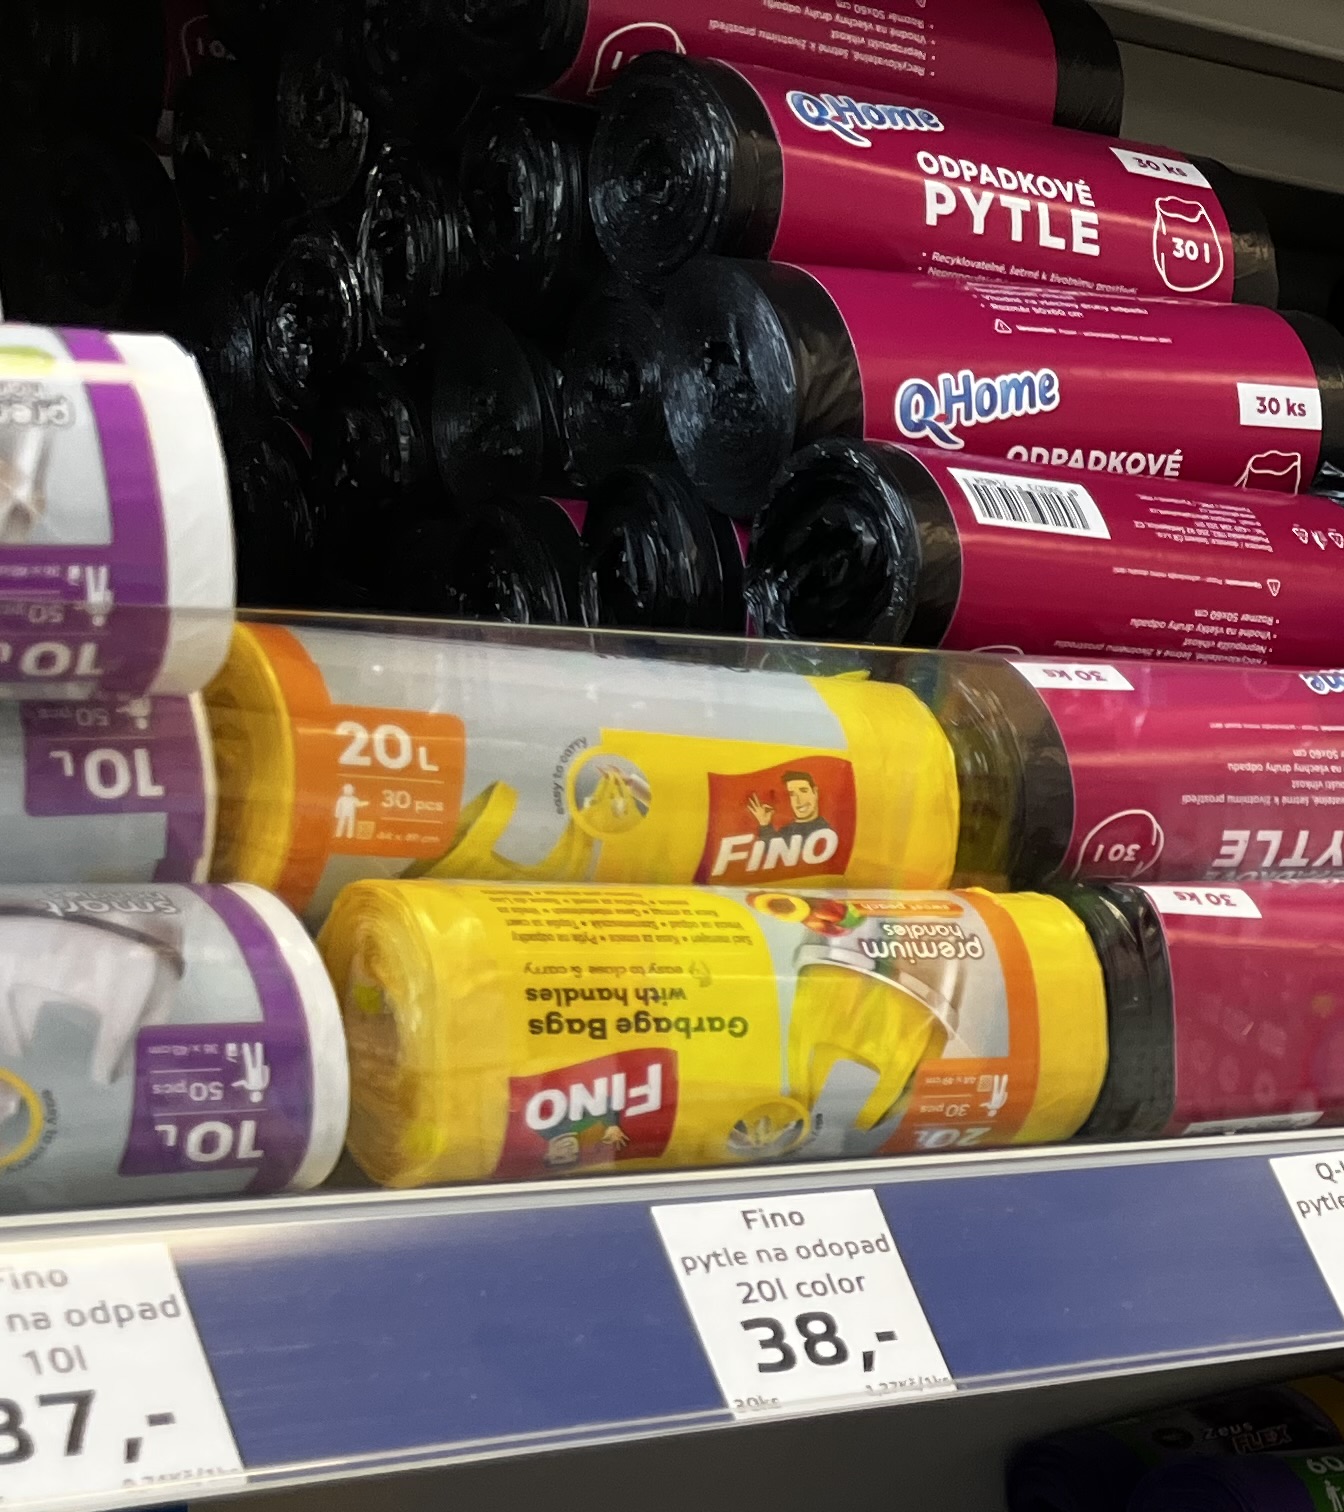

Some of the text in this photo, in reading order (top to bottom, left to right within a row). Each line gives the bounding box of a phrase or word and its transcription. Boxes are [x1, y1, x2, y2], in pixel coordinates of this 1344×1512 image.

[917, 151, 1094, 206] ODPADKOVÉ
[1134, 156, 1158, 173] 30
[924, 180, 1100, 256] PYTLE
[1255, 395, 1307, 416] 30 ks
[381, 790, 412, 810] 30
[711, 827, 839, 878] FINO
[862, 938, 985, 961] premium
[524, 985, 686, 1010] with handles
[528, 1010, 748, 1041] Garbage Bags
[524, 1062, 663, 1131] FINO
[741, 1207, 805, 1231] Fino
[680, 1233, 891, 1275] pytle na odopad
[795, 1271, 866, 1299] color
[6, 1294, 181, 1332] na odpad
[741, 1313, 900, 1375] 38,-
